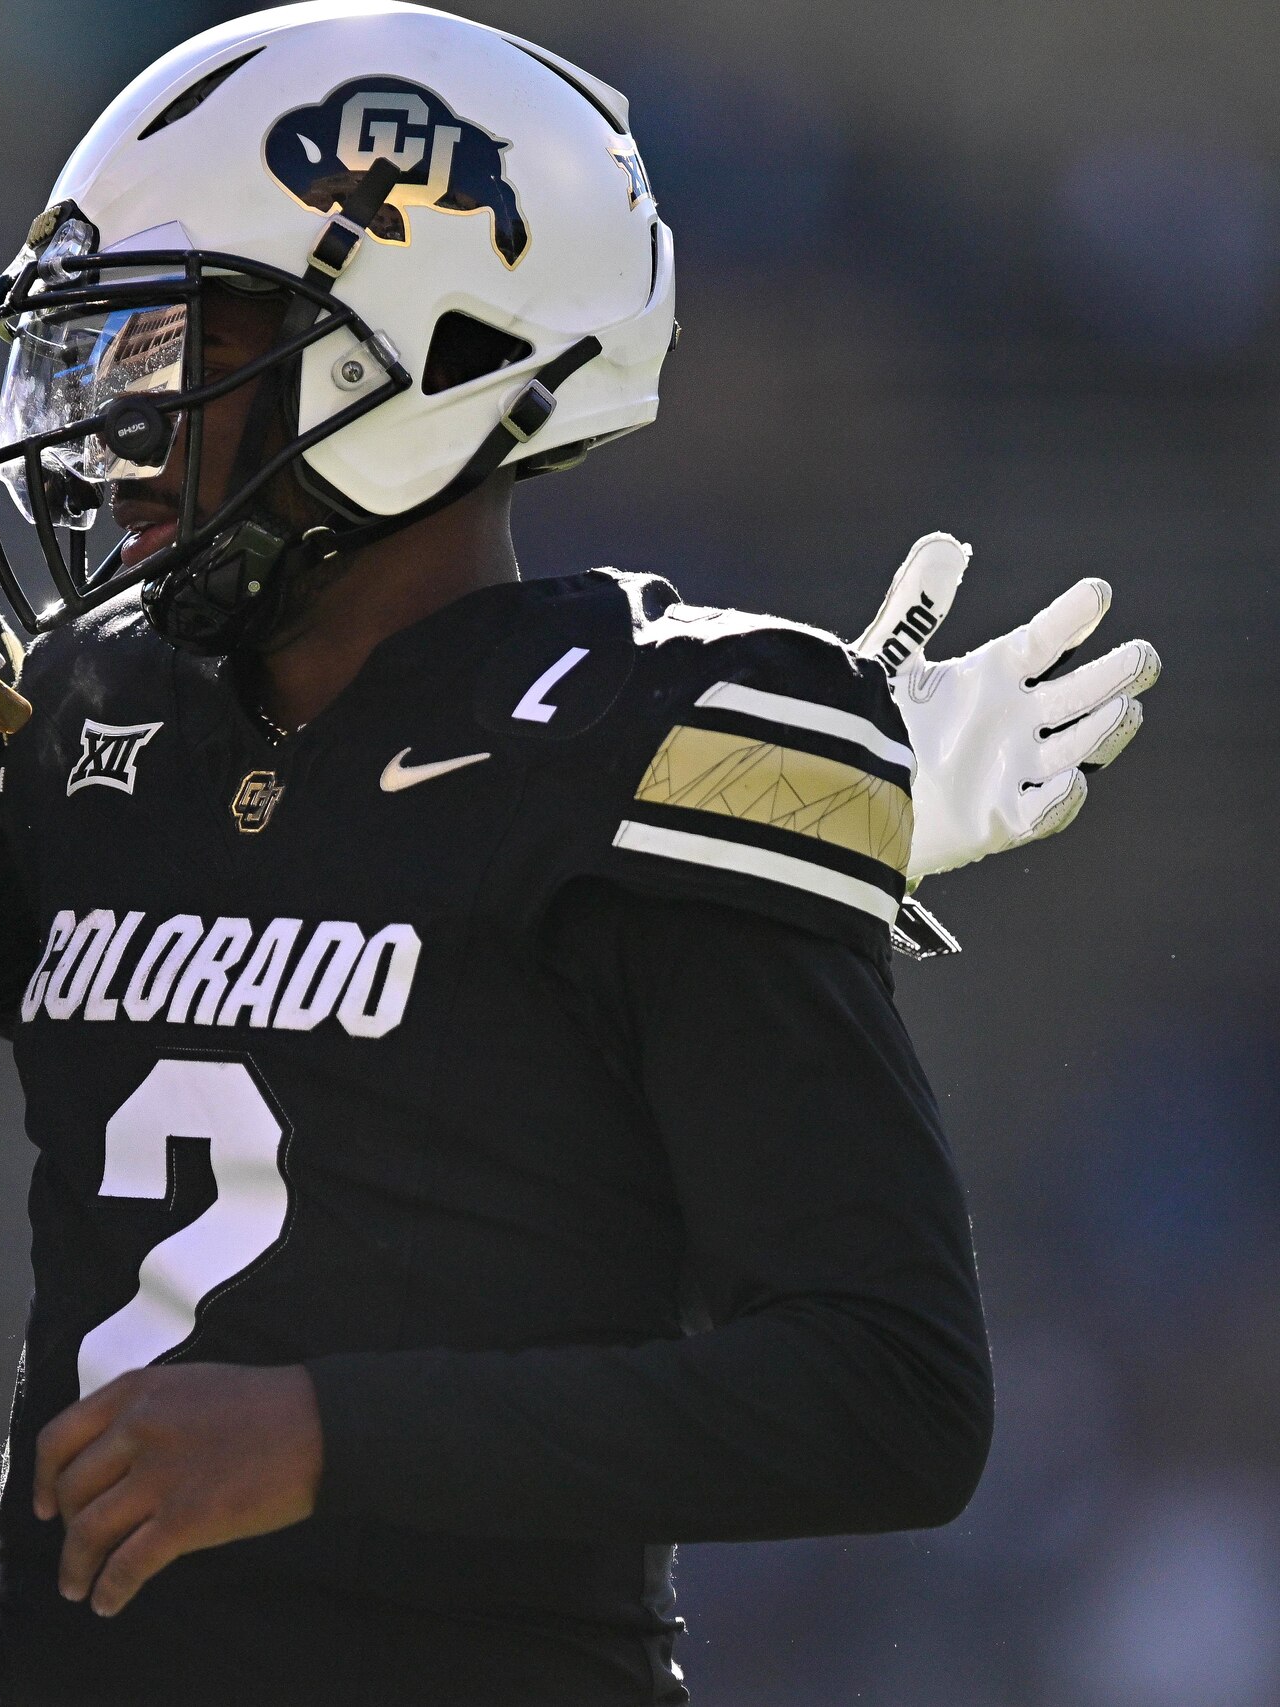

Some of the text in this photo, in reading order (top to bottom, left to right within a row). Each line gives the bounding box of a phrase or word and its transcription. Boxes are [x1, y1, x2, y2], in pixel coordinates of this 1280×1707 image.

[335, 91, 462, 208] CU
[72, 727, 154, 786] XII
[228, 769, 286, 834] CU
[20, 908, 424, 1039] COLORADO
[77, 1058, 289, 1402] 2
